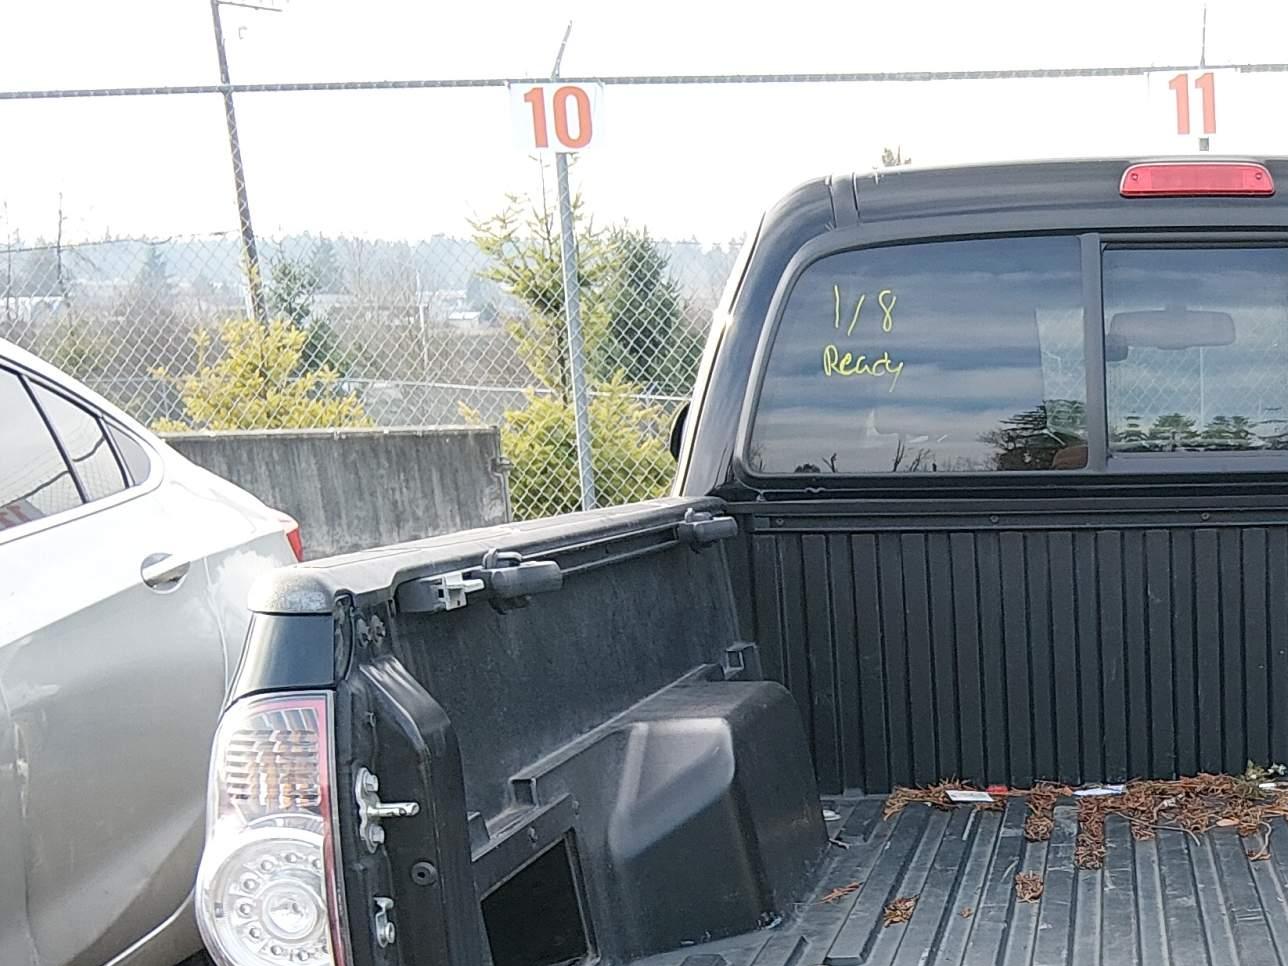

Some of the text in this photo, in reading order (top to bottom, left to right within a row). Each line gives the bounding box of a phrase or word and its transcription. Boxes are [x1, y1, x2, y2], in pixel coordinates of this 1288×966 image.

[523, 85, 593, 149] 10
[1168, 72, 1217, 135] 11
[823, 344, 904, 393] Ready
